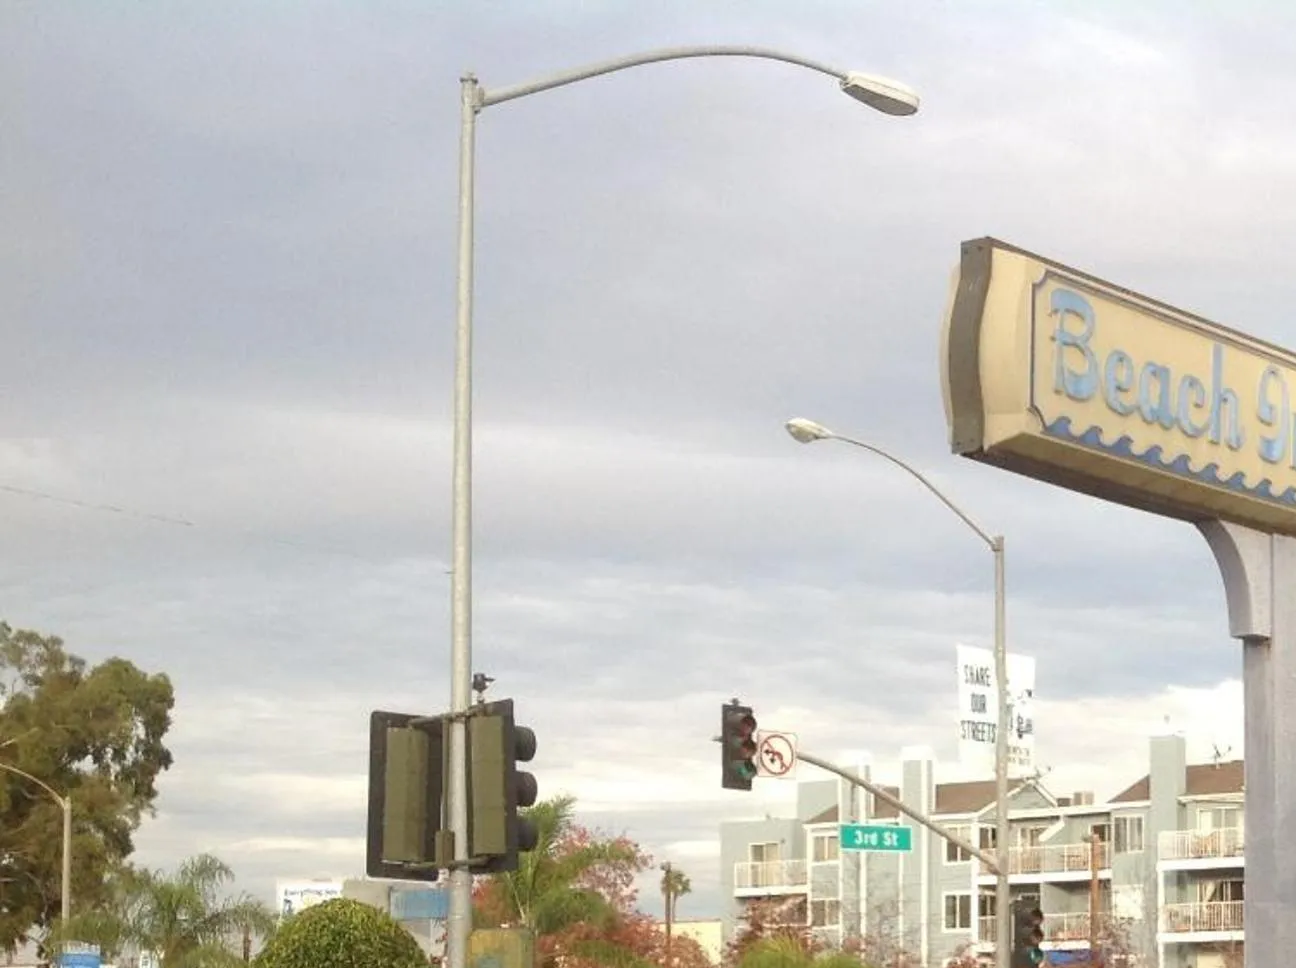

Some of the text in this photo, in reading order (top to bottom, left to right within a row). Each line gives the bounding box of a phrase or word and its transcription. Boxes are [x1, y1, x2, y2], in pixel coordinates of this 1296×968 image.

[1050, 287, 1245, 451] Beach
[963, 663, 992, 688] SHARE
[960, 719, 996, 744] STREETS
[853, 829, 899, 847] 3rd St
